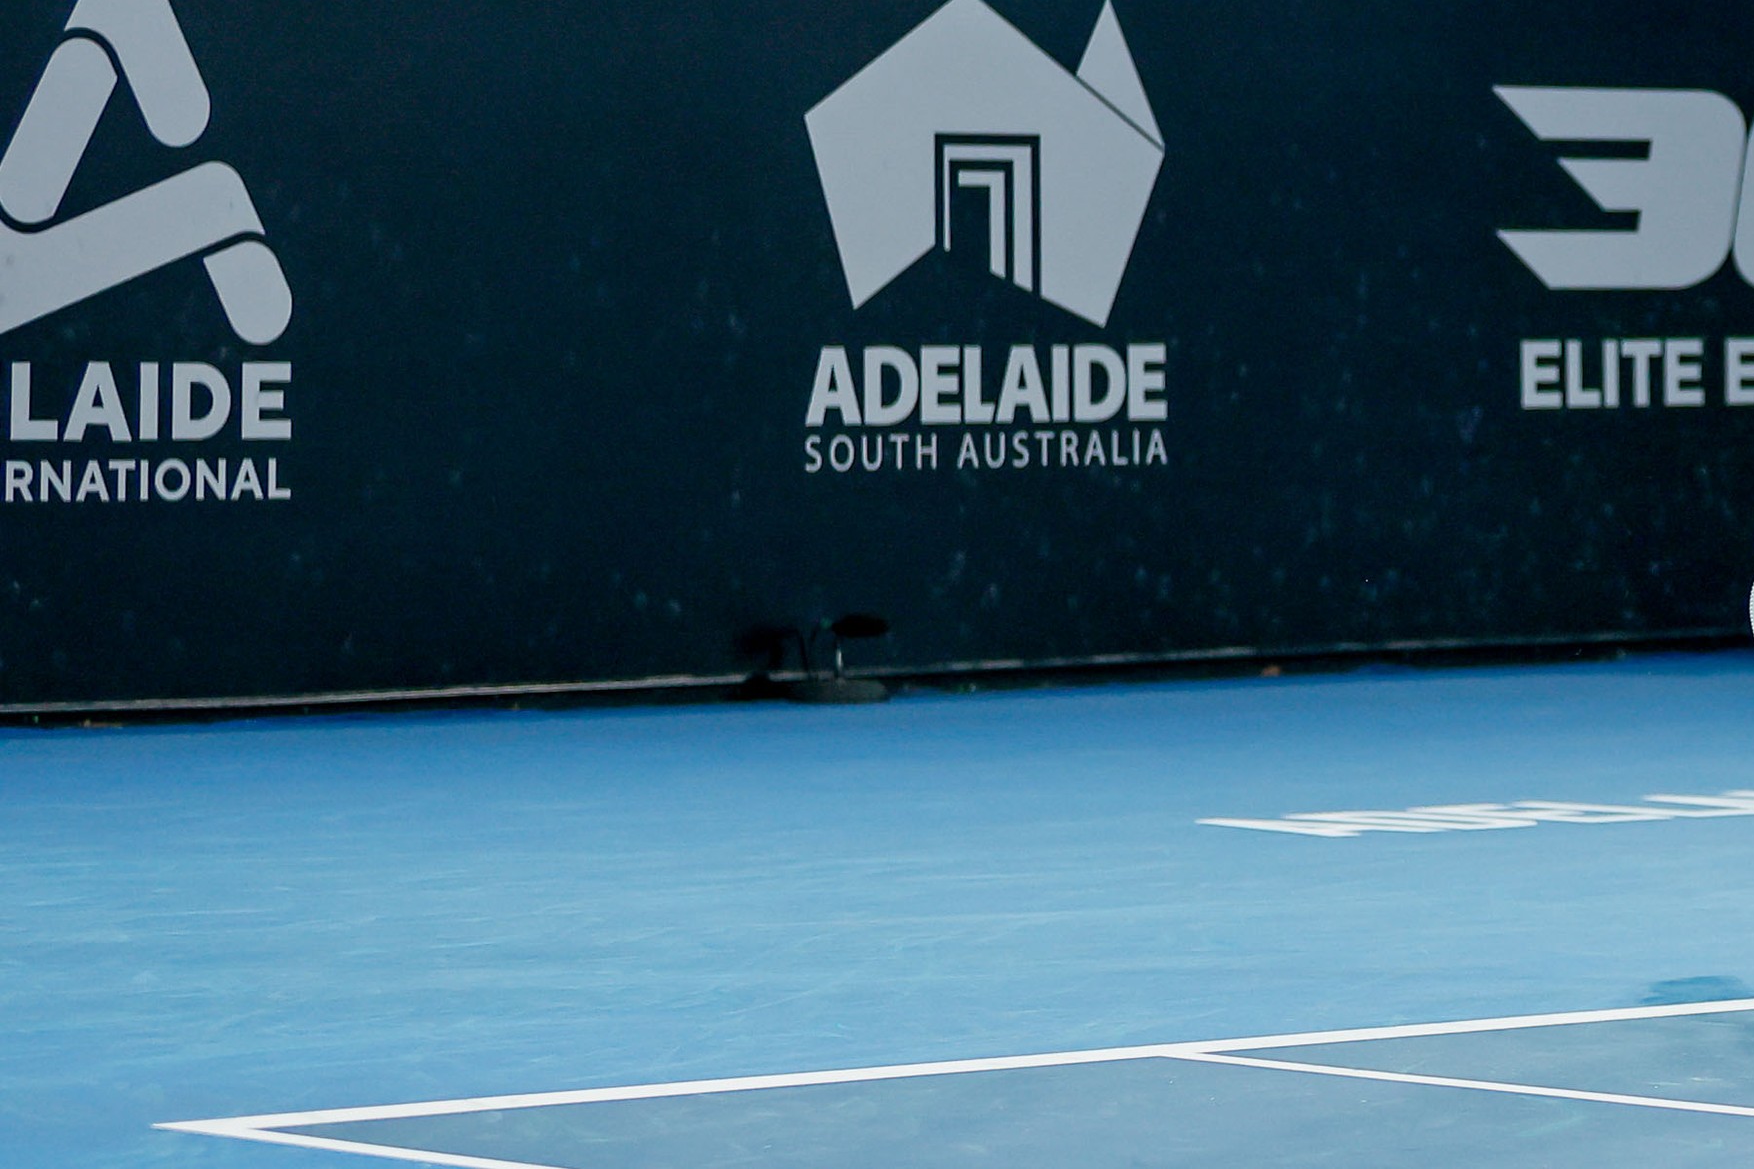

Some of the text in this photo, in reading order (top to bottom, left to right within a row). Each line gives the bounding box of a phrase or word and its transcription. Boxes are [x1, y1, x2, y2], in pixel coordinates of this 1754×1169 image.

[804, 342, 1169, 427] ADELAIDE
[1519, 337, 1706, 410] ELITE
[804, 428, 1169, 473] SOUTH AUSTRALIA
